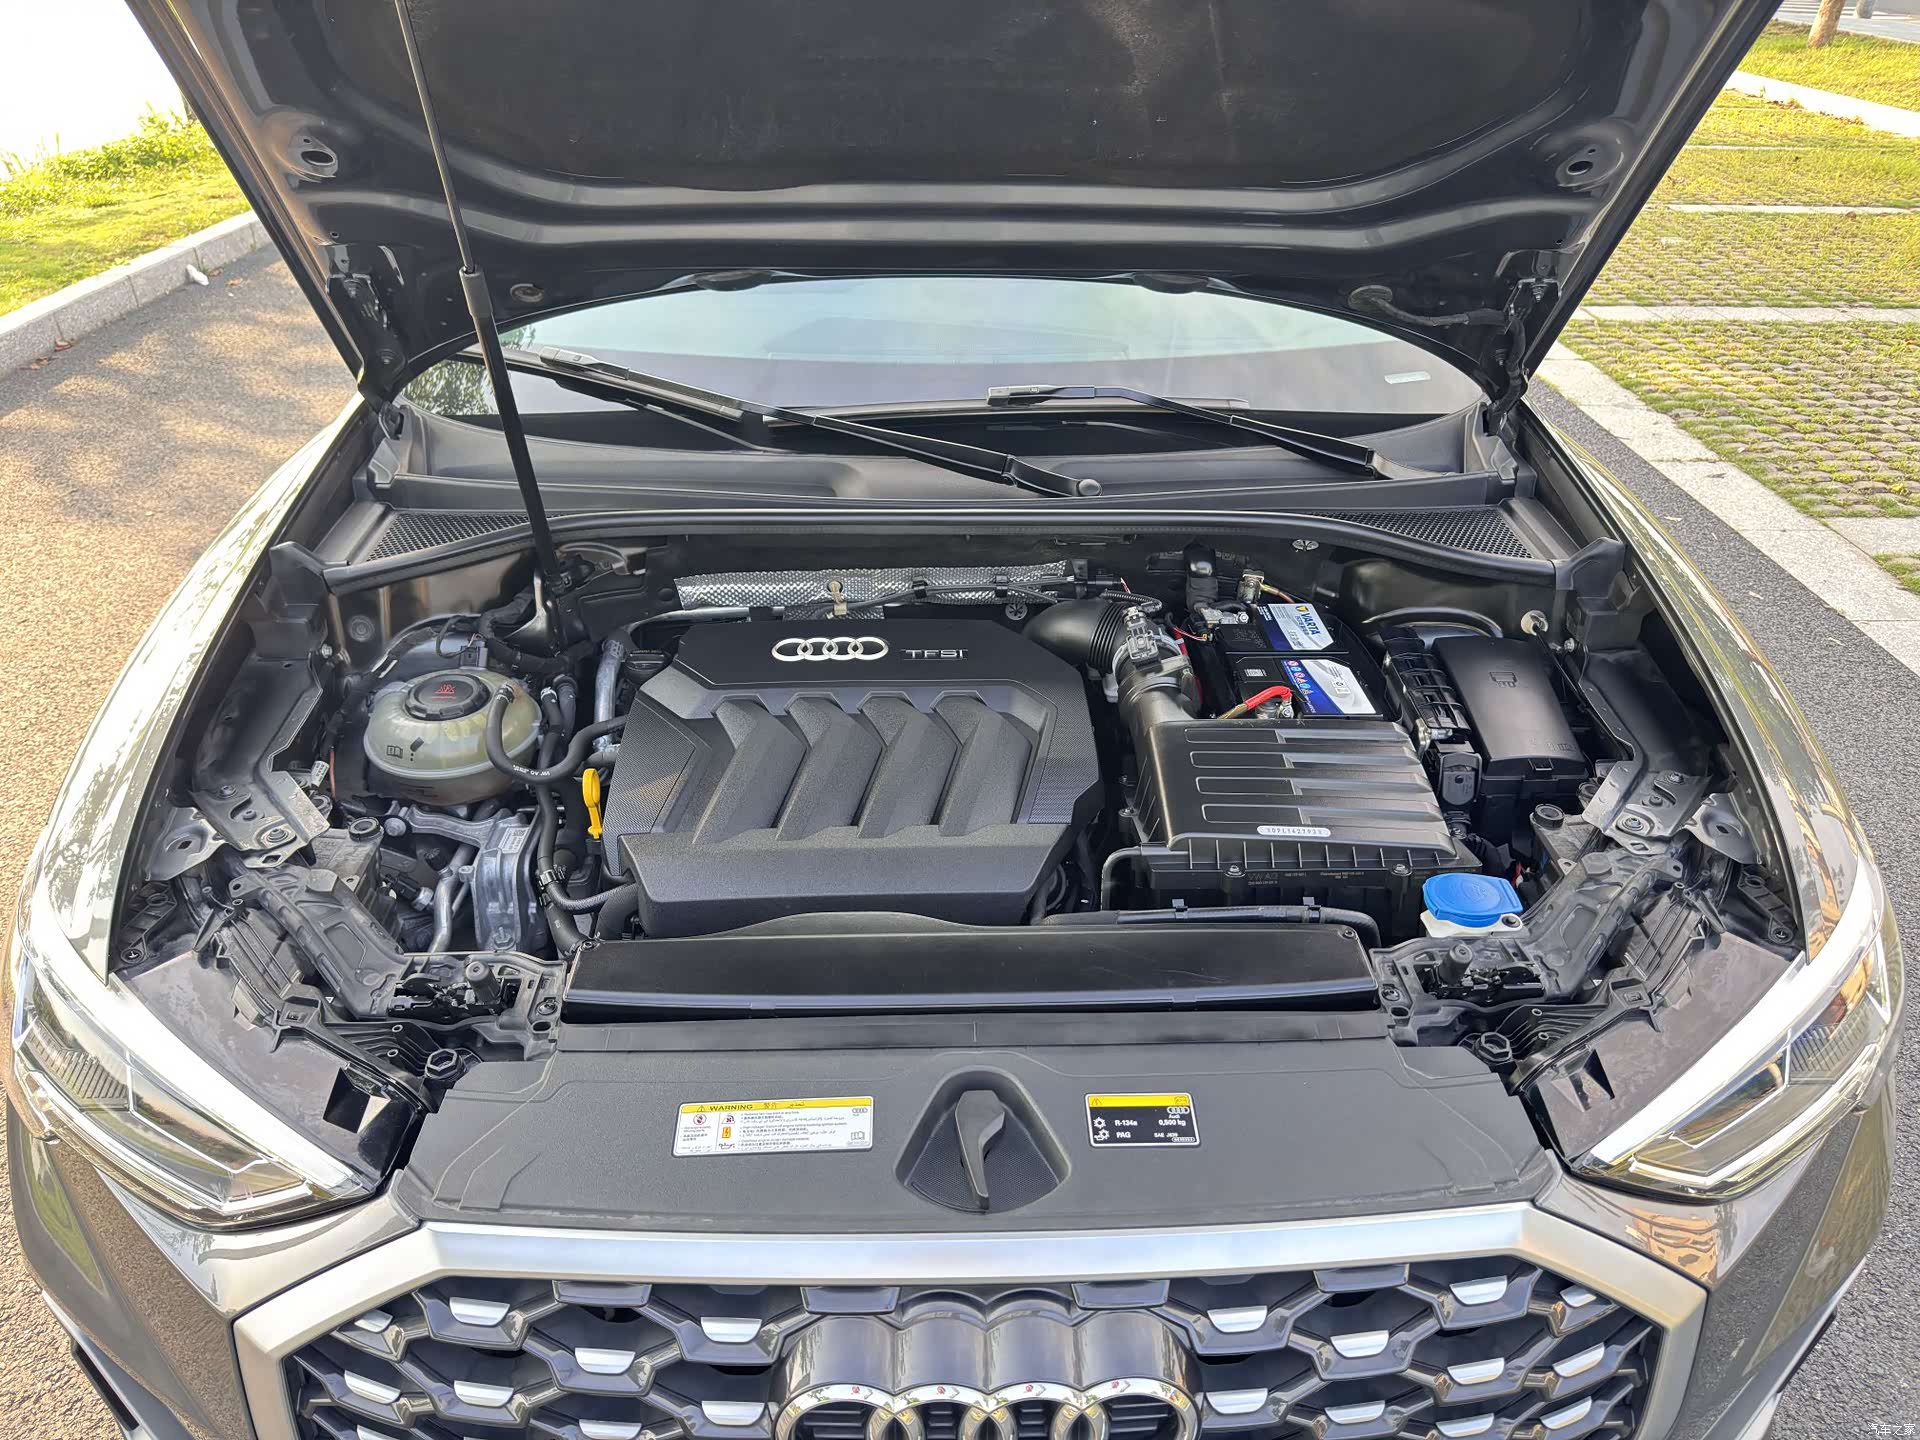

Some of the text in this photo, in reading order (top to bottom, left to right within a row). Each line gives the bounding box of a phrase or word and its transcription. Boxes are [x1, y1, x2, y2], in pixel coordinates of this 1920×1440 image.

[1300, 611, 1321, 636] VARTA
[905, 649, 965, 659] TFSI
[1248, 873, 1263, 881] VW
[709, 1103, 753, 1112] WARNING
[1114, 1119, 1138, 1127] R-134a
[1177, 1119, 1187, 1127] kg
